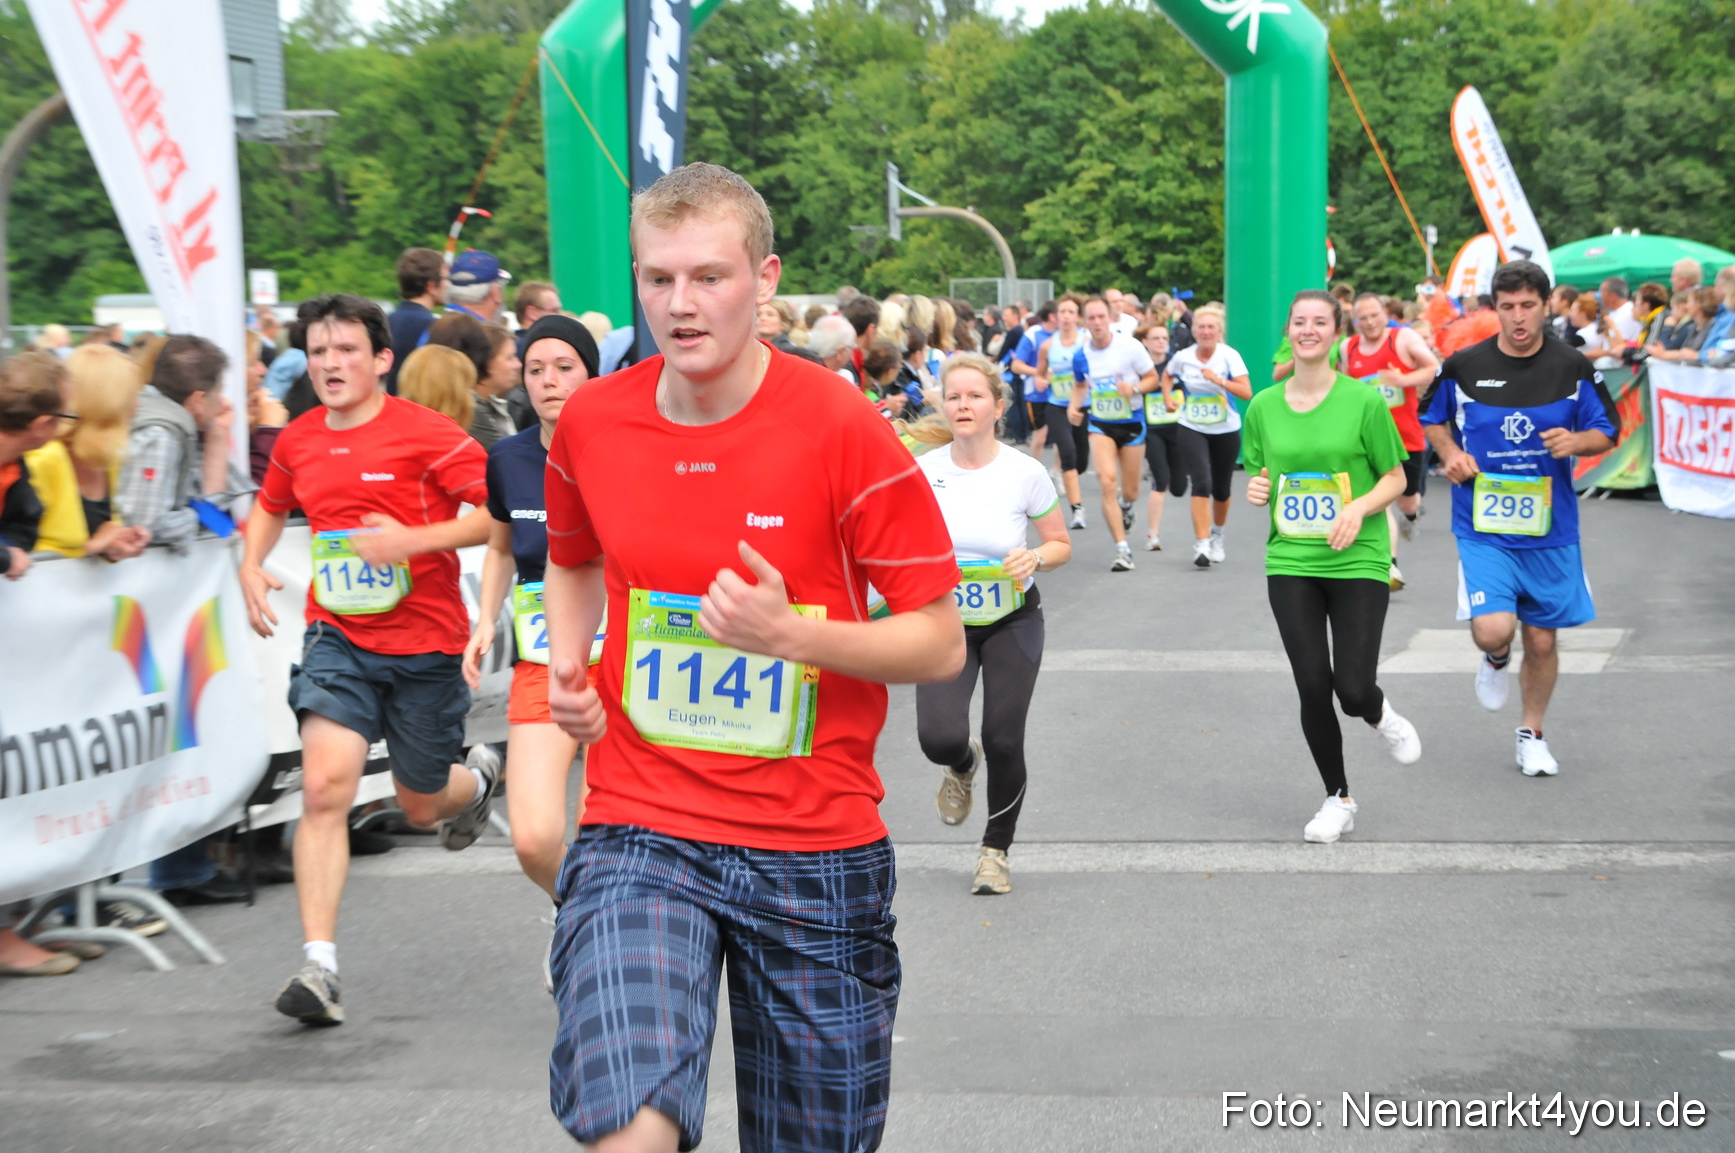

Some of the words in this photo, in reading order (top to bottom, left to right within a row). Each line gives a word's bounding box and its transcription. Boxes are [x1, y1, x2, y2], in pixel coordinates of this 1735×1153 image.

[1096, 398, 1122, 411] 670
[1191, 404, 1218, 417] 934
[689, 462, 716, 472] JAKO
[1283, 496, 1336, 521] 803
[1483, 494, 1535, 519] 298
[746, 512, 784, 529] Eugen
[319, 562, 394, 592] 1149
[636, 648, 784, 714] 1141
[668, 708, 717, 727] Eugen
